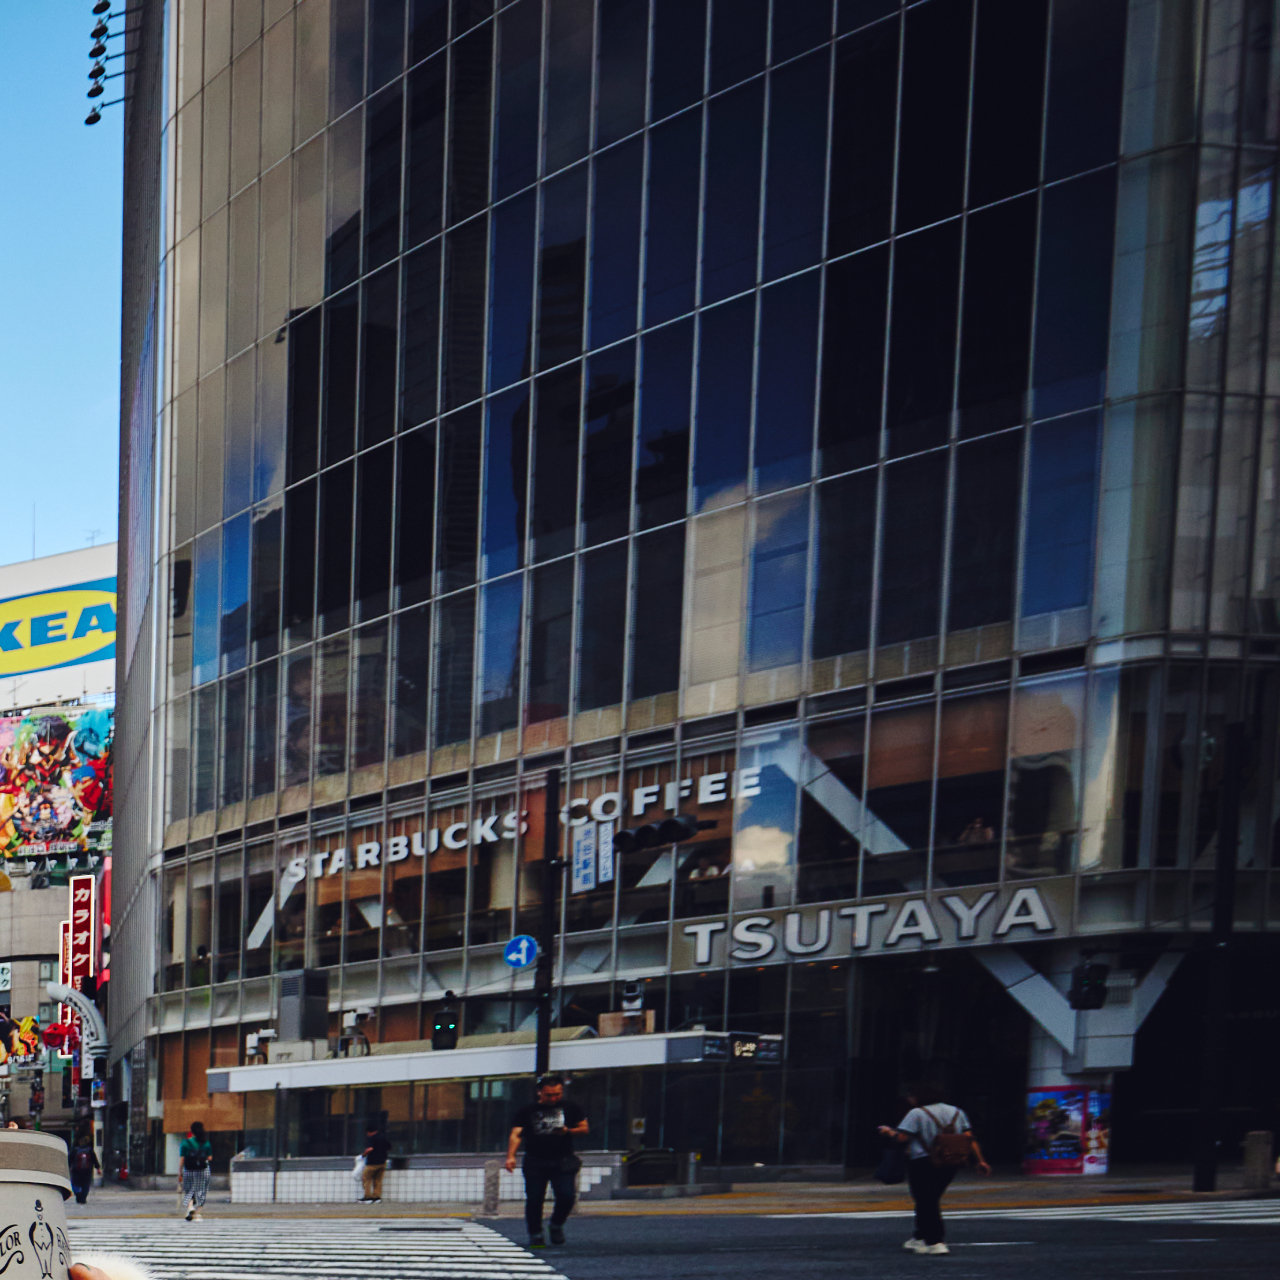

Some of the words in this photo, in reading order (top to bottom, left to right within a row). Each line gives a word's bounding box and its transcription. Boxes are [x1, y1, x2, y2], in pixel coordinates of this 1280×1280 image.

[560, 765, 762, 828] COFFEE
[287, 809, 529, 883] STARBUCKS
[73, 886, 90, 968] カラオケ
[683, 886, 1055, 966] TSUTAYA
